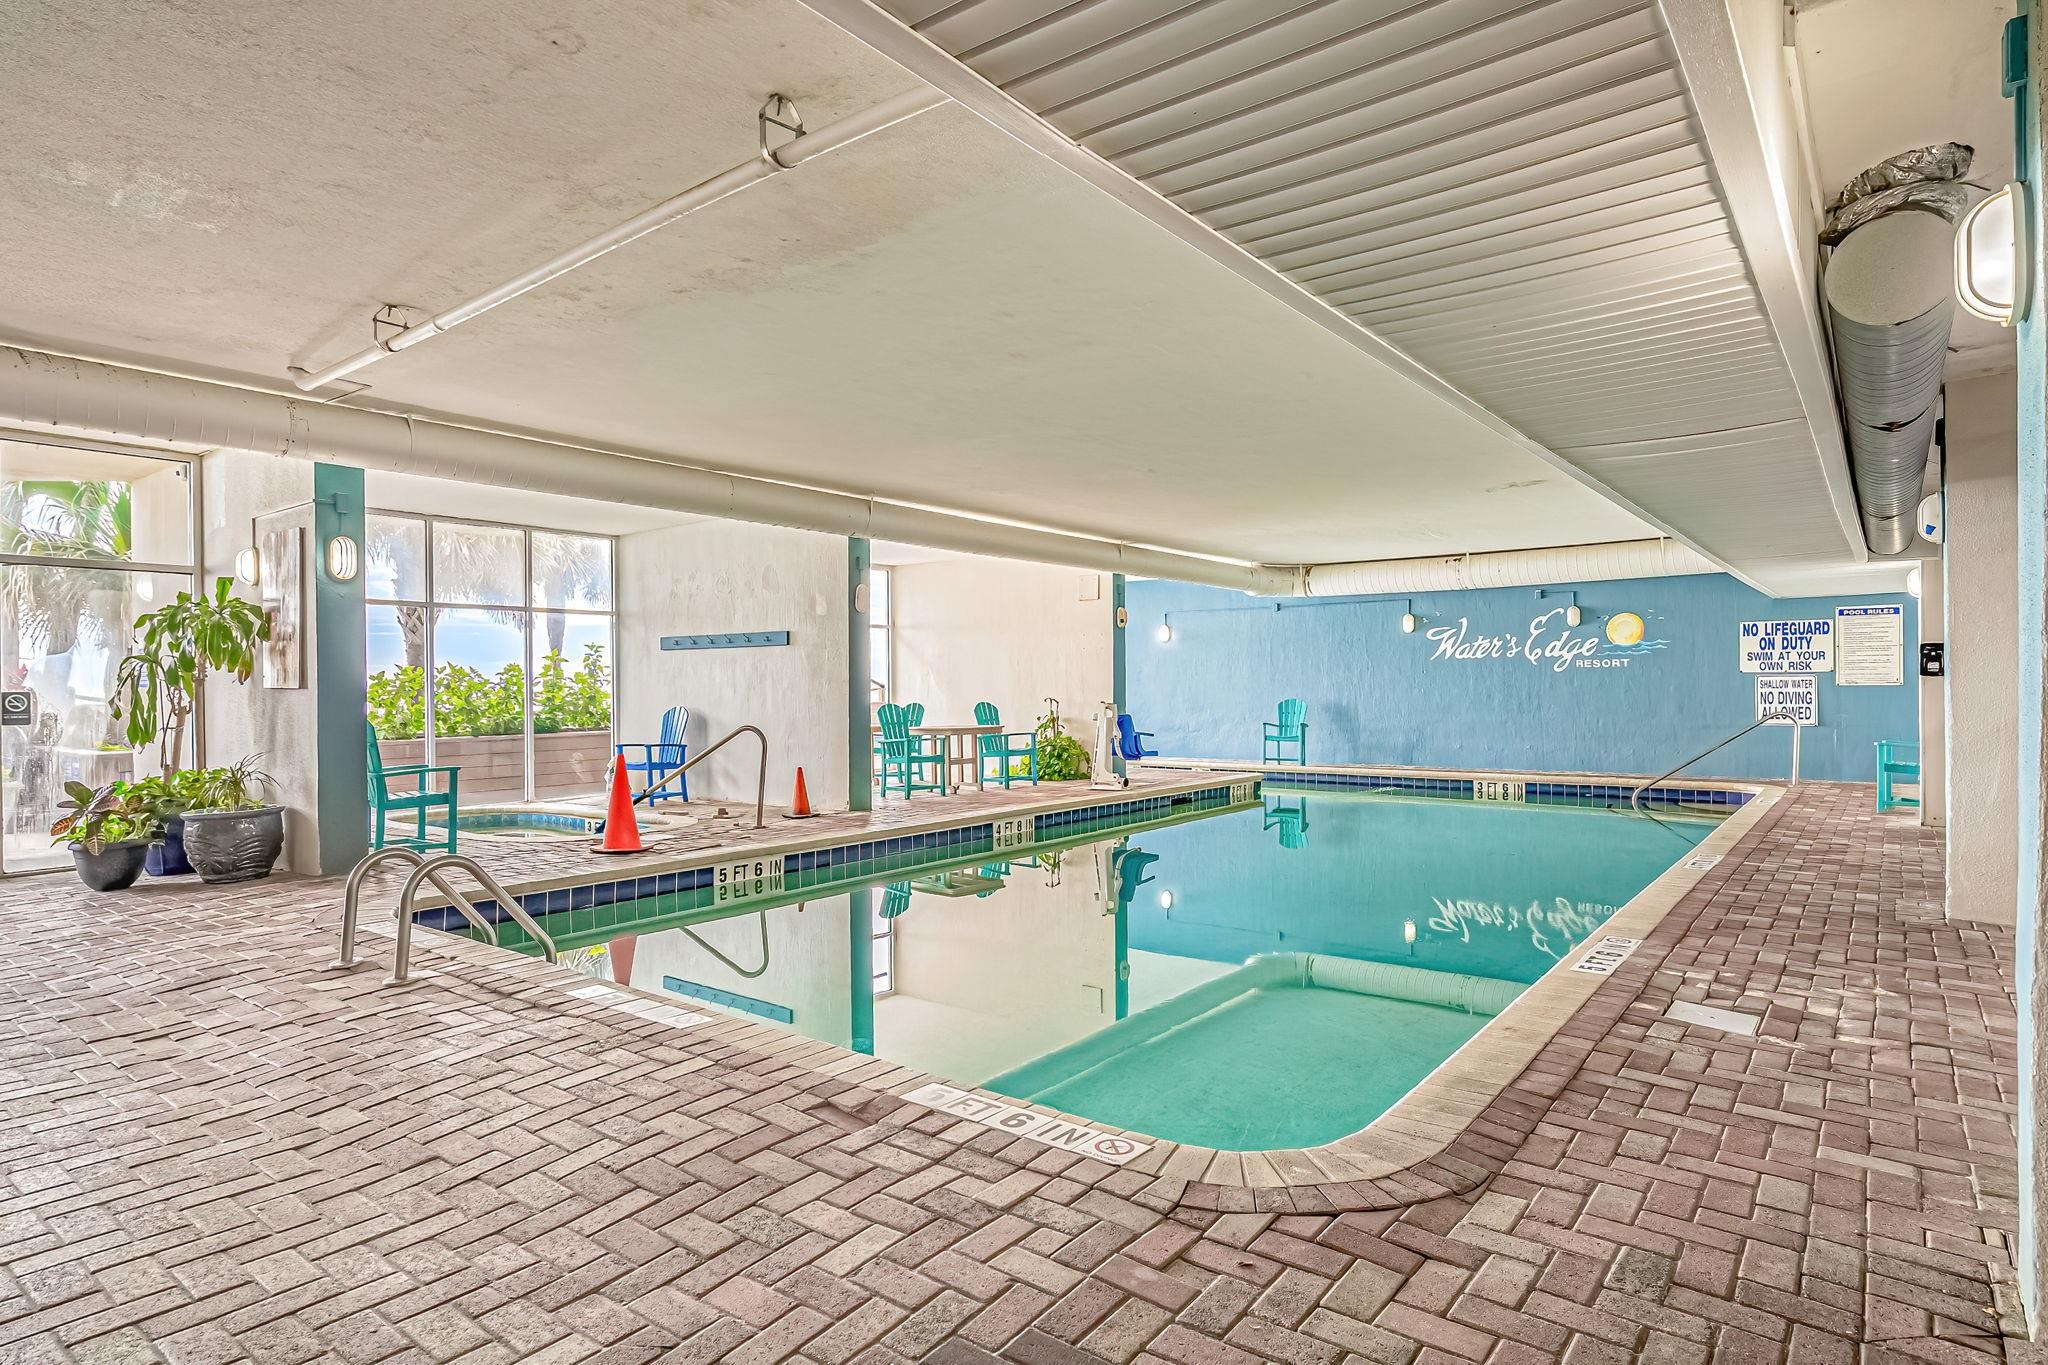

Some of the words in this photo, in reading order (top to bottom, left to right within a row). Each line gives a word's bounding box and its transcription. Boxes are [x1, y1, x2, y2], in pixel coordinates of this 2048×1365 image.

[1742, 623, 1759, 636] NO
[1764, 621, 1830, 636] LIFEGUARD
[1426, 617, 1521, 661] Water's
[1524, 608, 1599, 672] Edge
[1759, 637, 1775, 650] ON
[1781, 636, 1812, 650] DUTY
[1747, 652, 1773, 661] SWIM
[1778, 651, 1791, 660] AT
[1796, 651, 1826, 660] YOUR
[1576, 659, 1630, 668] RESORT
[1759, 662, 1783, 671] OWN
[1788, 661, 1812, 670] RISK
[1760, 680, 1789, 689] SHALLOW
[1791, 679, 1813, 688] WATER
[1760, 691, 1774, 705] NO
[1778, 691, 1812, 705] DIVING
[1477, 782, 1483, 791] 3
[588, 821, 592, 832] 3
[996, 824, 1001, 835] 4
[1005, 822, 1013, 833] FT
[1017, 821, 1022, 831] 8
[1025, 819, 1033, 830] IN
[720, 867, 727, 883] 5
[733, 864, 748, 881] FT
[754, 862, 763, 877] 6
[769, 859, 782, 875] IN
[947, 1097, 1003, 1116] FT
[1000, 1112, 1036, 1128] 6
[1036, 1123, 1091, 1146] IN
